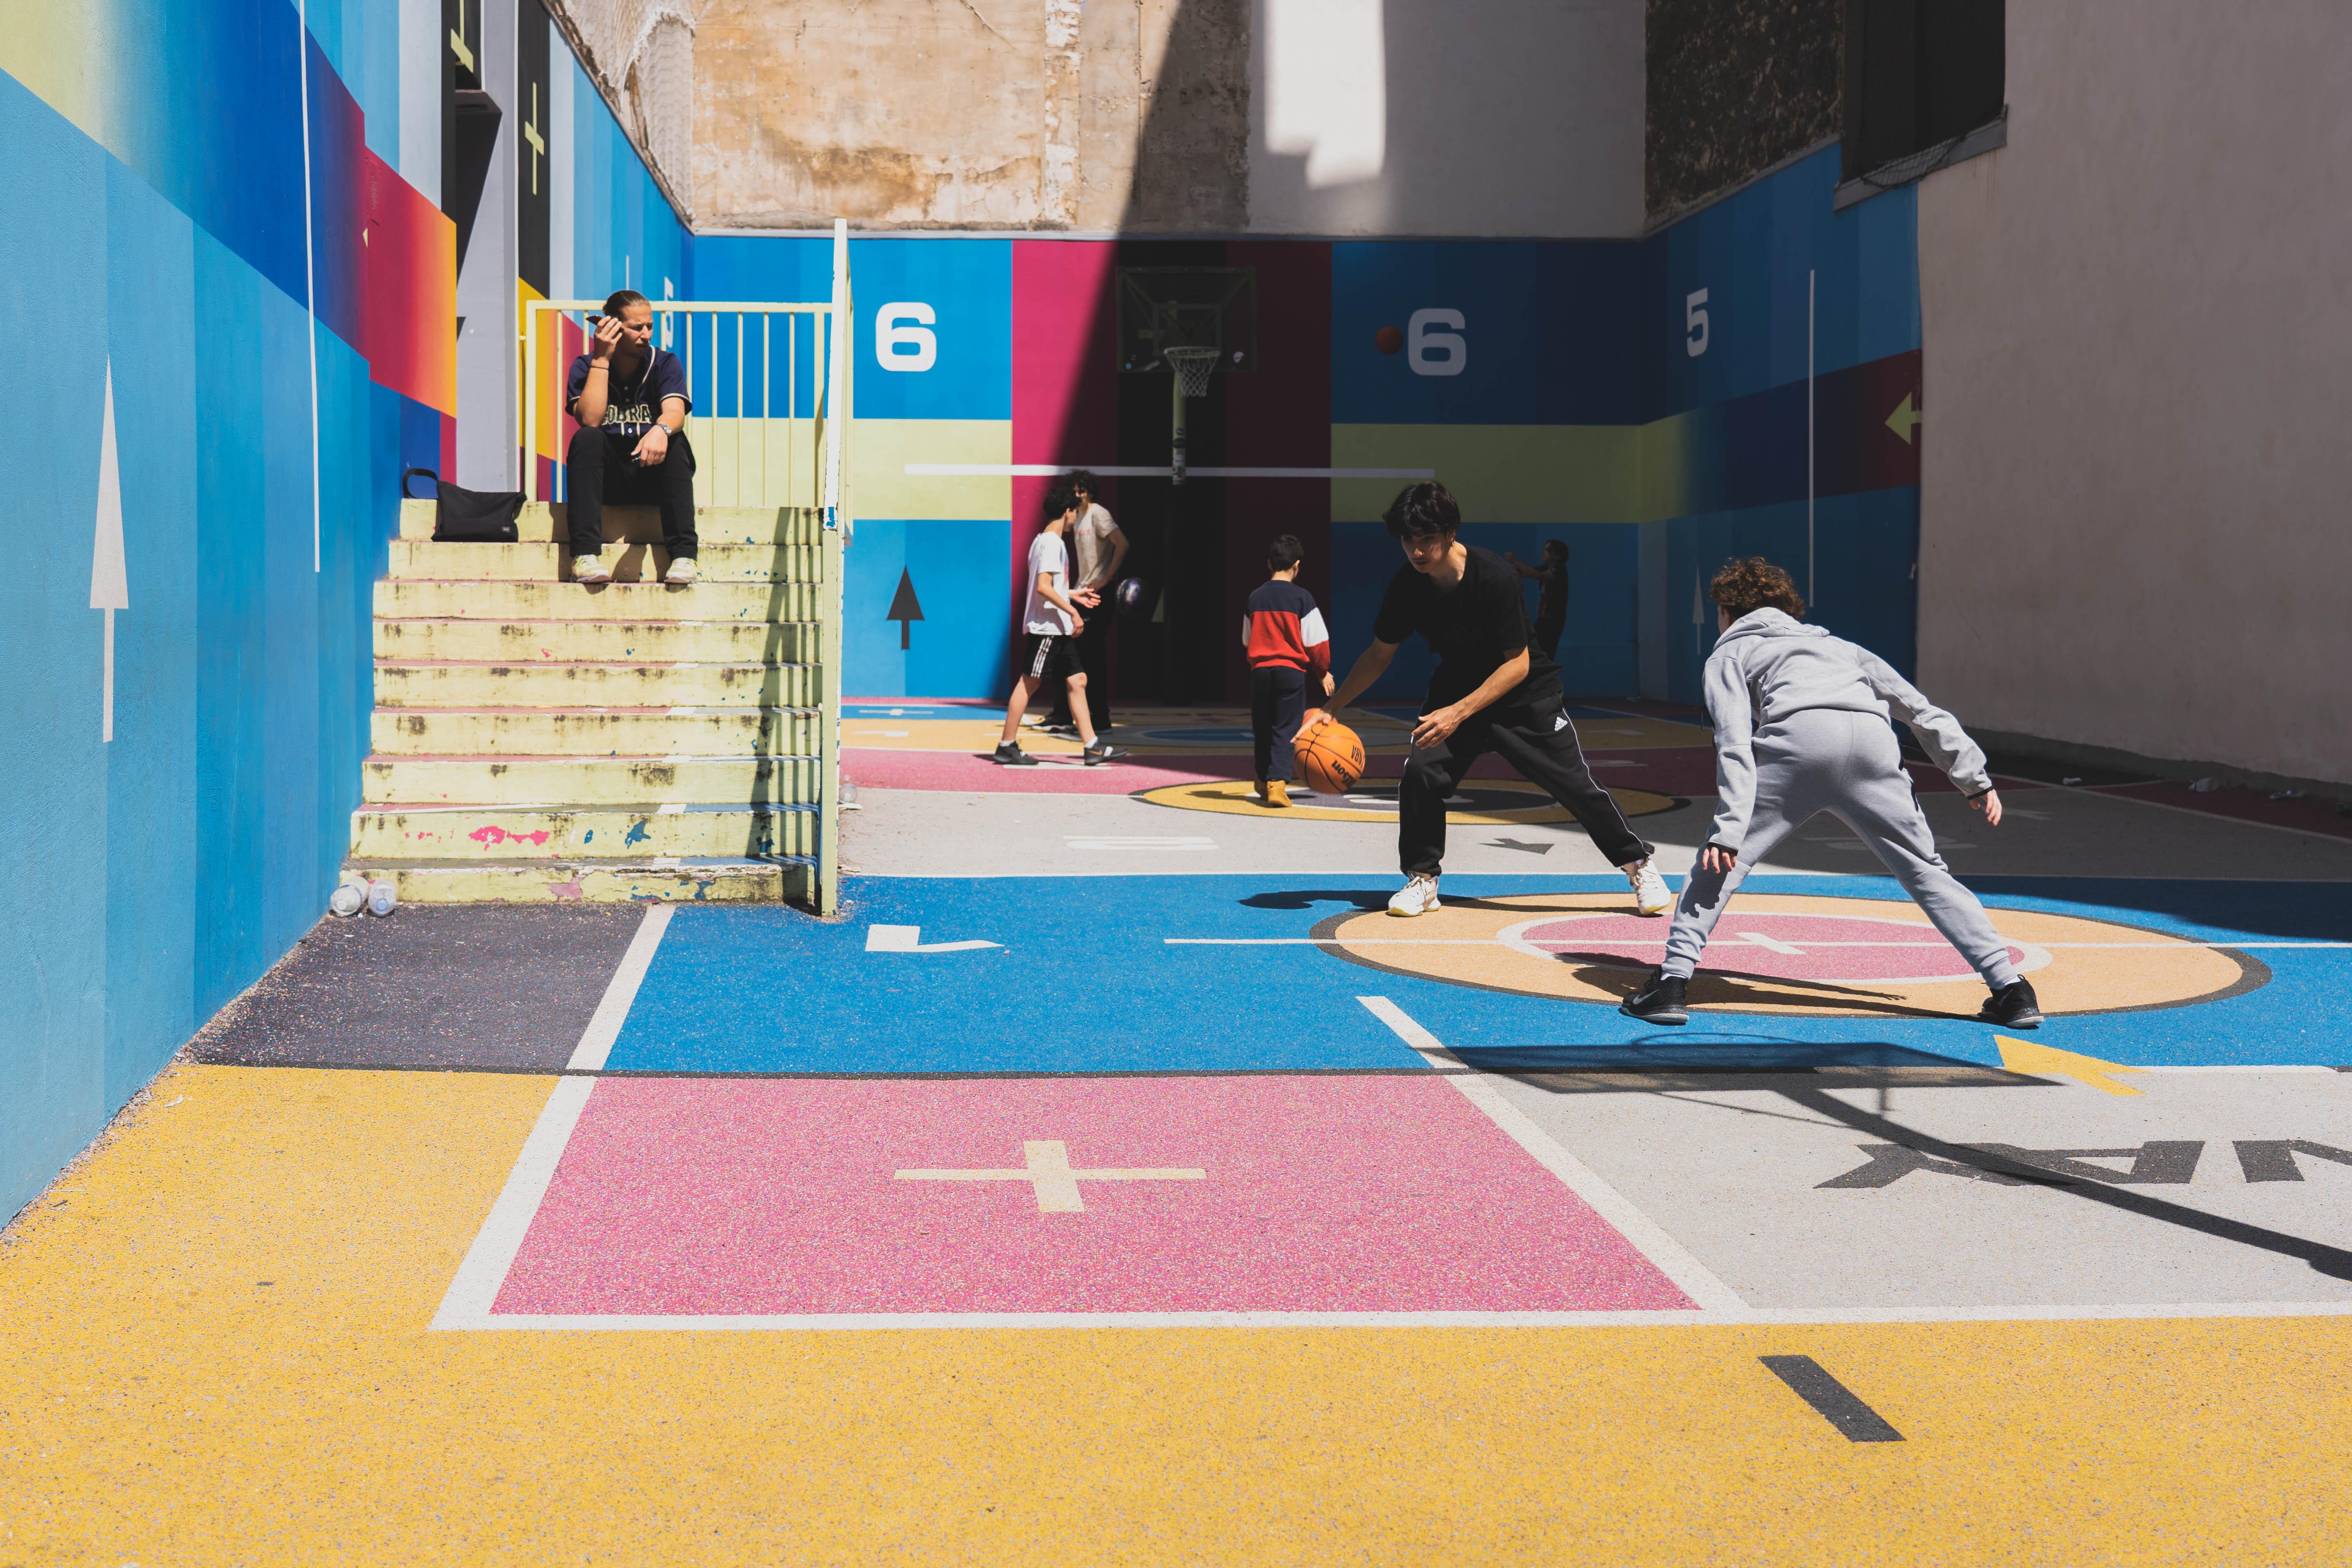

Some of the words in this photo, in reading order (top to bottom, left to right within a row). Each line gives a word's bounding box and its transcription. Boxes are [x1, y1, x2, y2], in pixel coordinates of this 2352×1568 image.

[875, 302, 937, 372] 6
[1408, 308, 1467, 376] 6
[1686, 287, 1709, 358] 5
